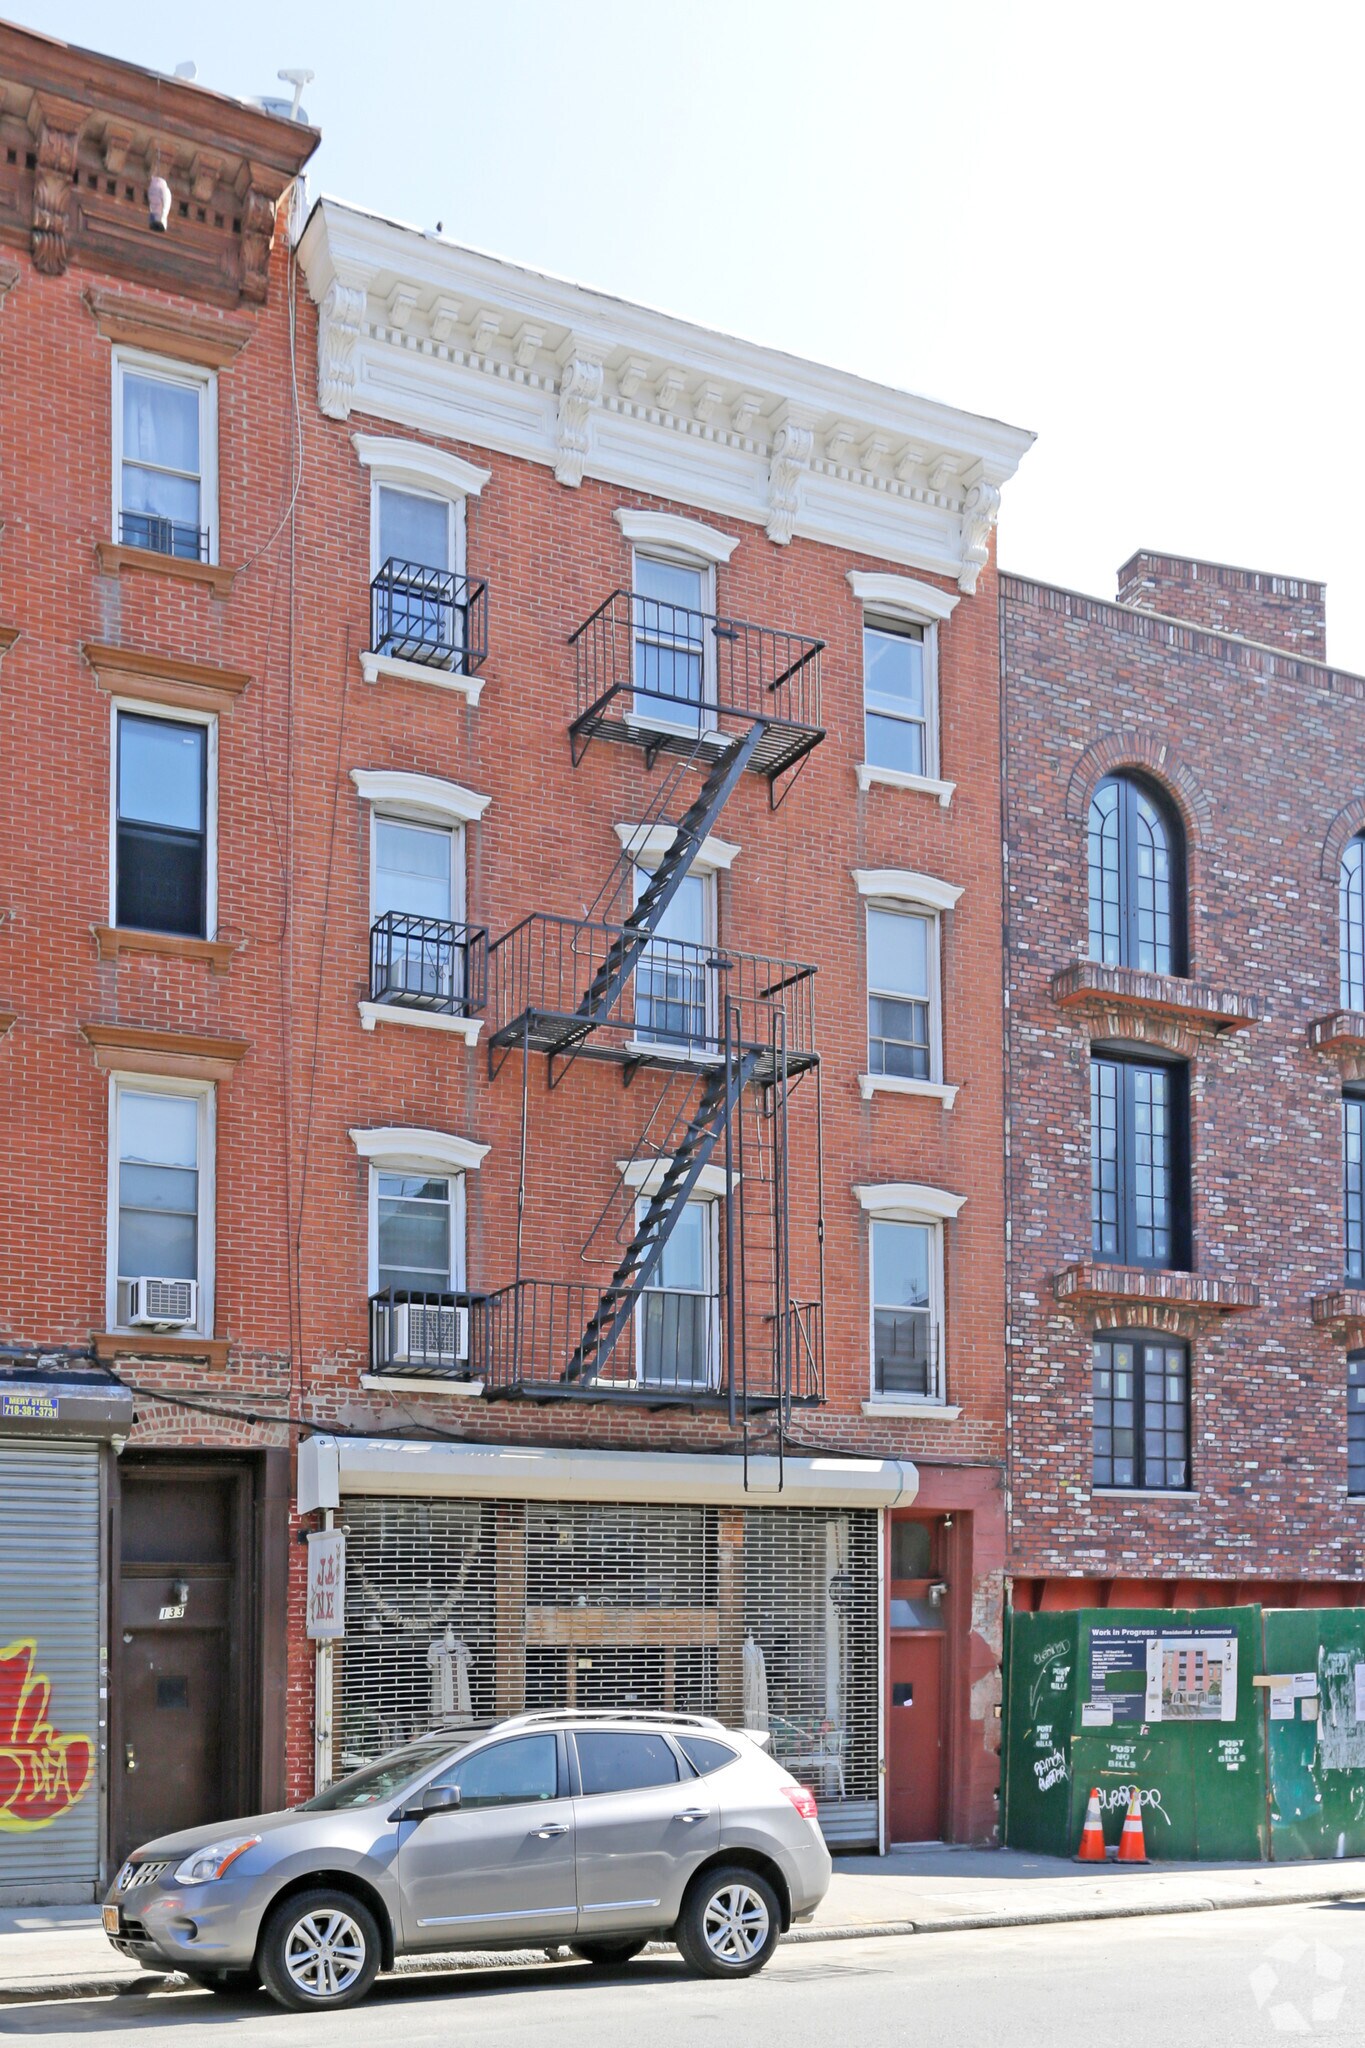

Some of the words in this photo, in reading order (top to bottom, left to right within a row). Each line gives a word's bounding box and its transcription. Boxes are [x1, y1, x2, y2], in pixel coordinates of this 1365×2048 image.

[9, 1397, 30, 1405] MERY
[31, 1399, 53, 1407] STEEL
[5, 1405, 57, 1417] 718-381-3731
[162, 1607, 183, 1618] 133
[1122, 1629, 1157, 1637] Progress:
[1037, 1725, 1053, 1733] POST
[1110, 1745, 1136, 1753] POST
[1115, 1753, 1130, 1761] NO
[1108, 1760, 1136, 1768] BILLS
